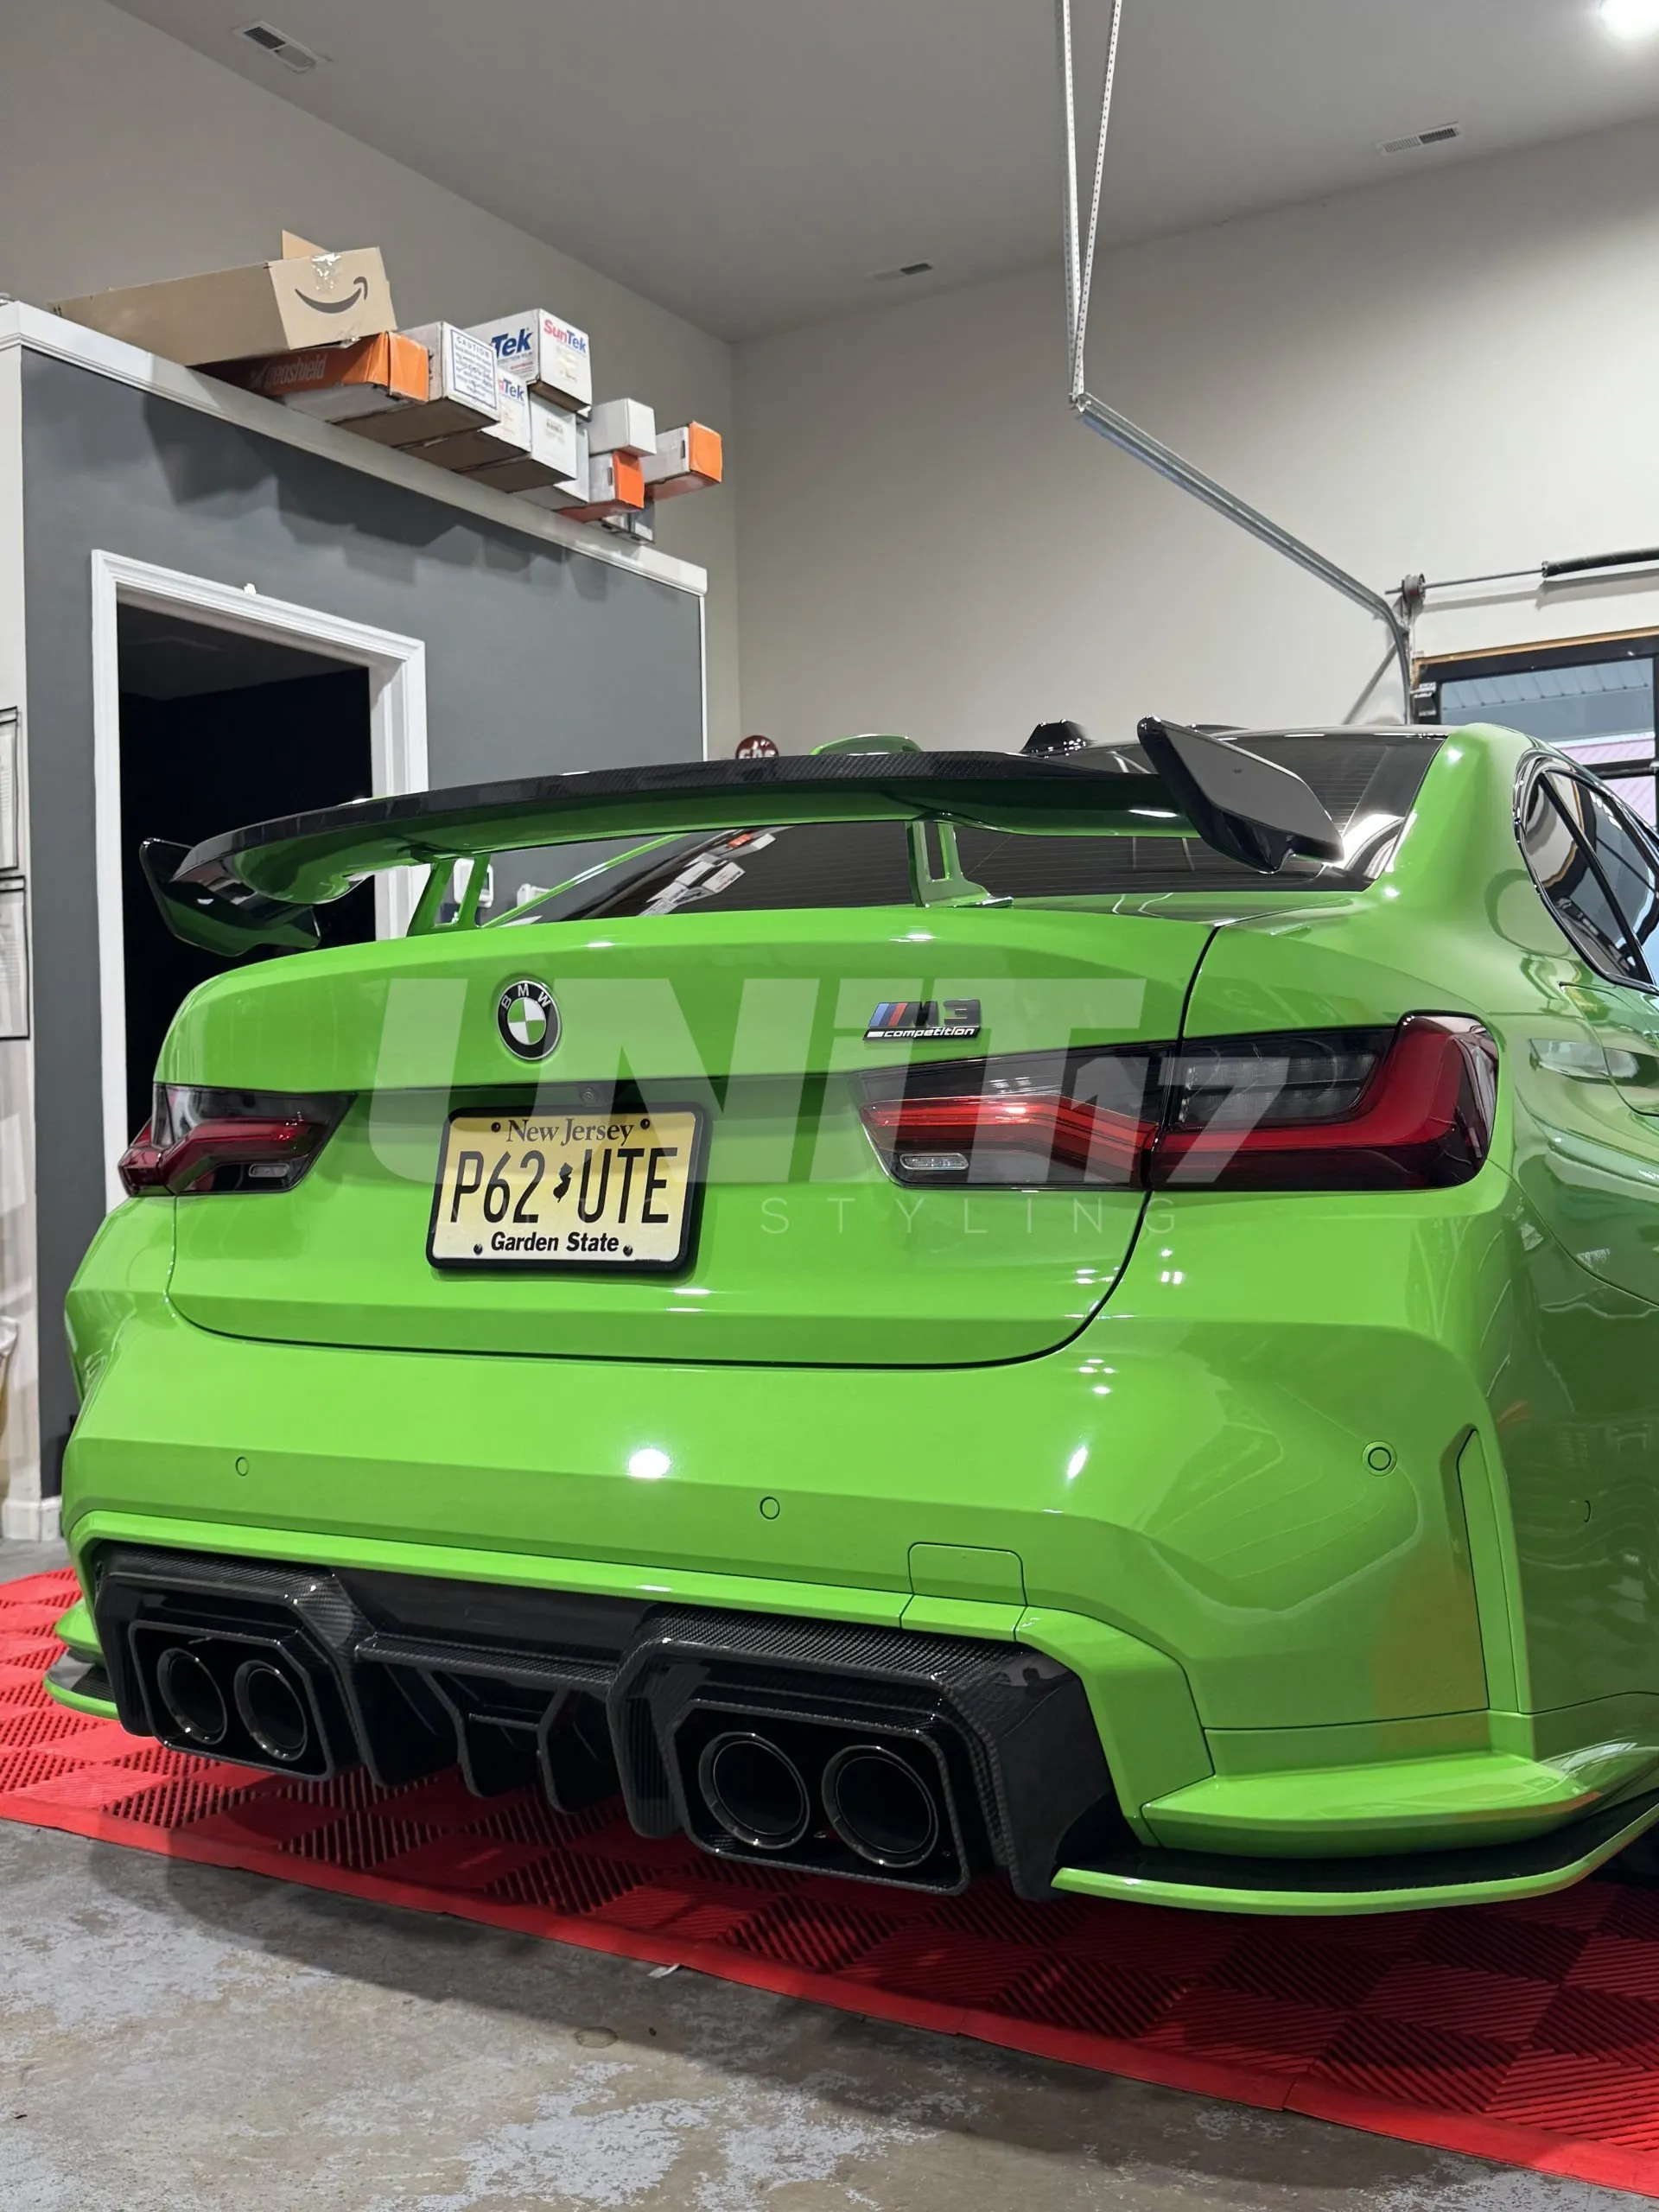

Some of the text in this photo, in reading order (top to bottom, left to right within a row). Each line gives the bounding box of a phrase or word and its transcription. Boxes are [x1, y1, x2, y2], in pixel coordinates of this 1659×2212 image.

[491, 328, 534, 358] Tek
[544, 319, 586, 353] SunTek
[498, 378, 524, 402] nTek
[501, 983, 551, 1009] BMW
[883, 1027, 976, 1039] competition
[506, 1118, 634, 1147] New Jersey
[491, 1231, 620, 1252] Garden State
